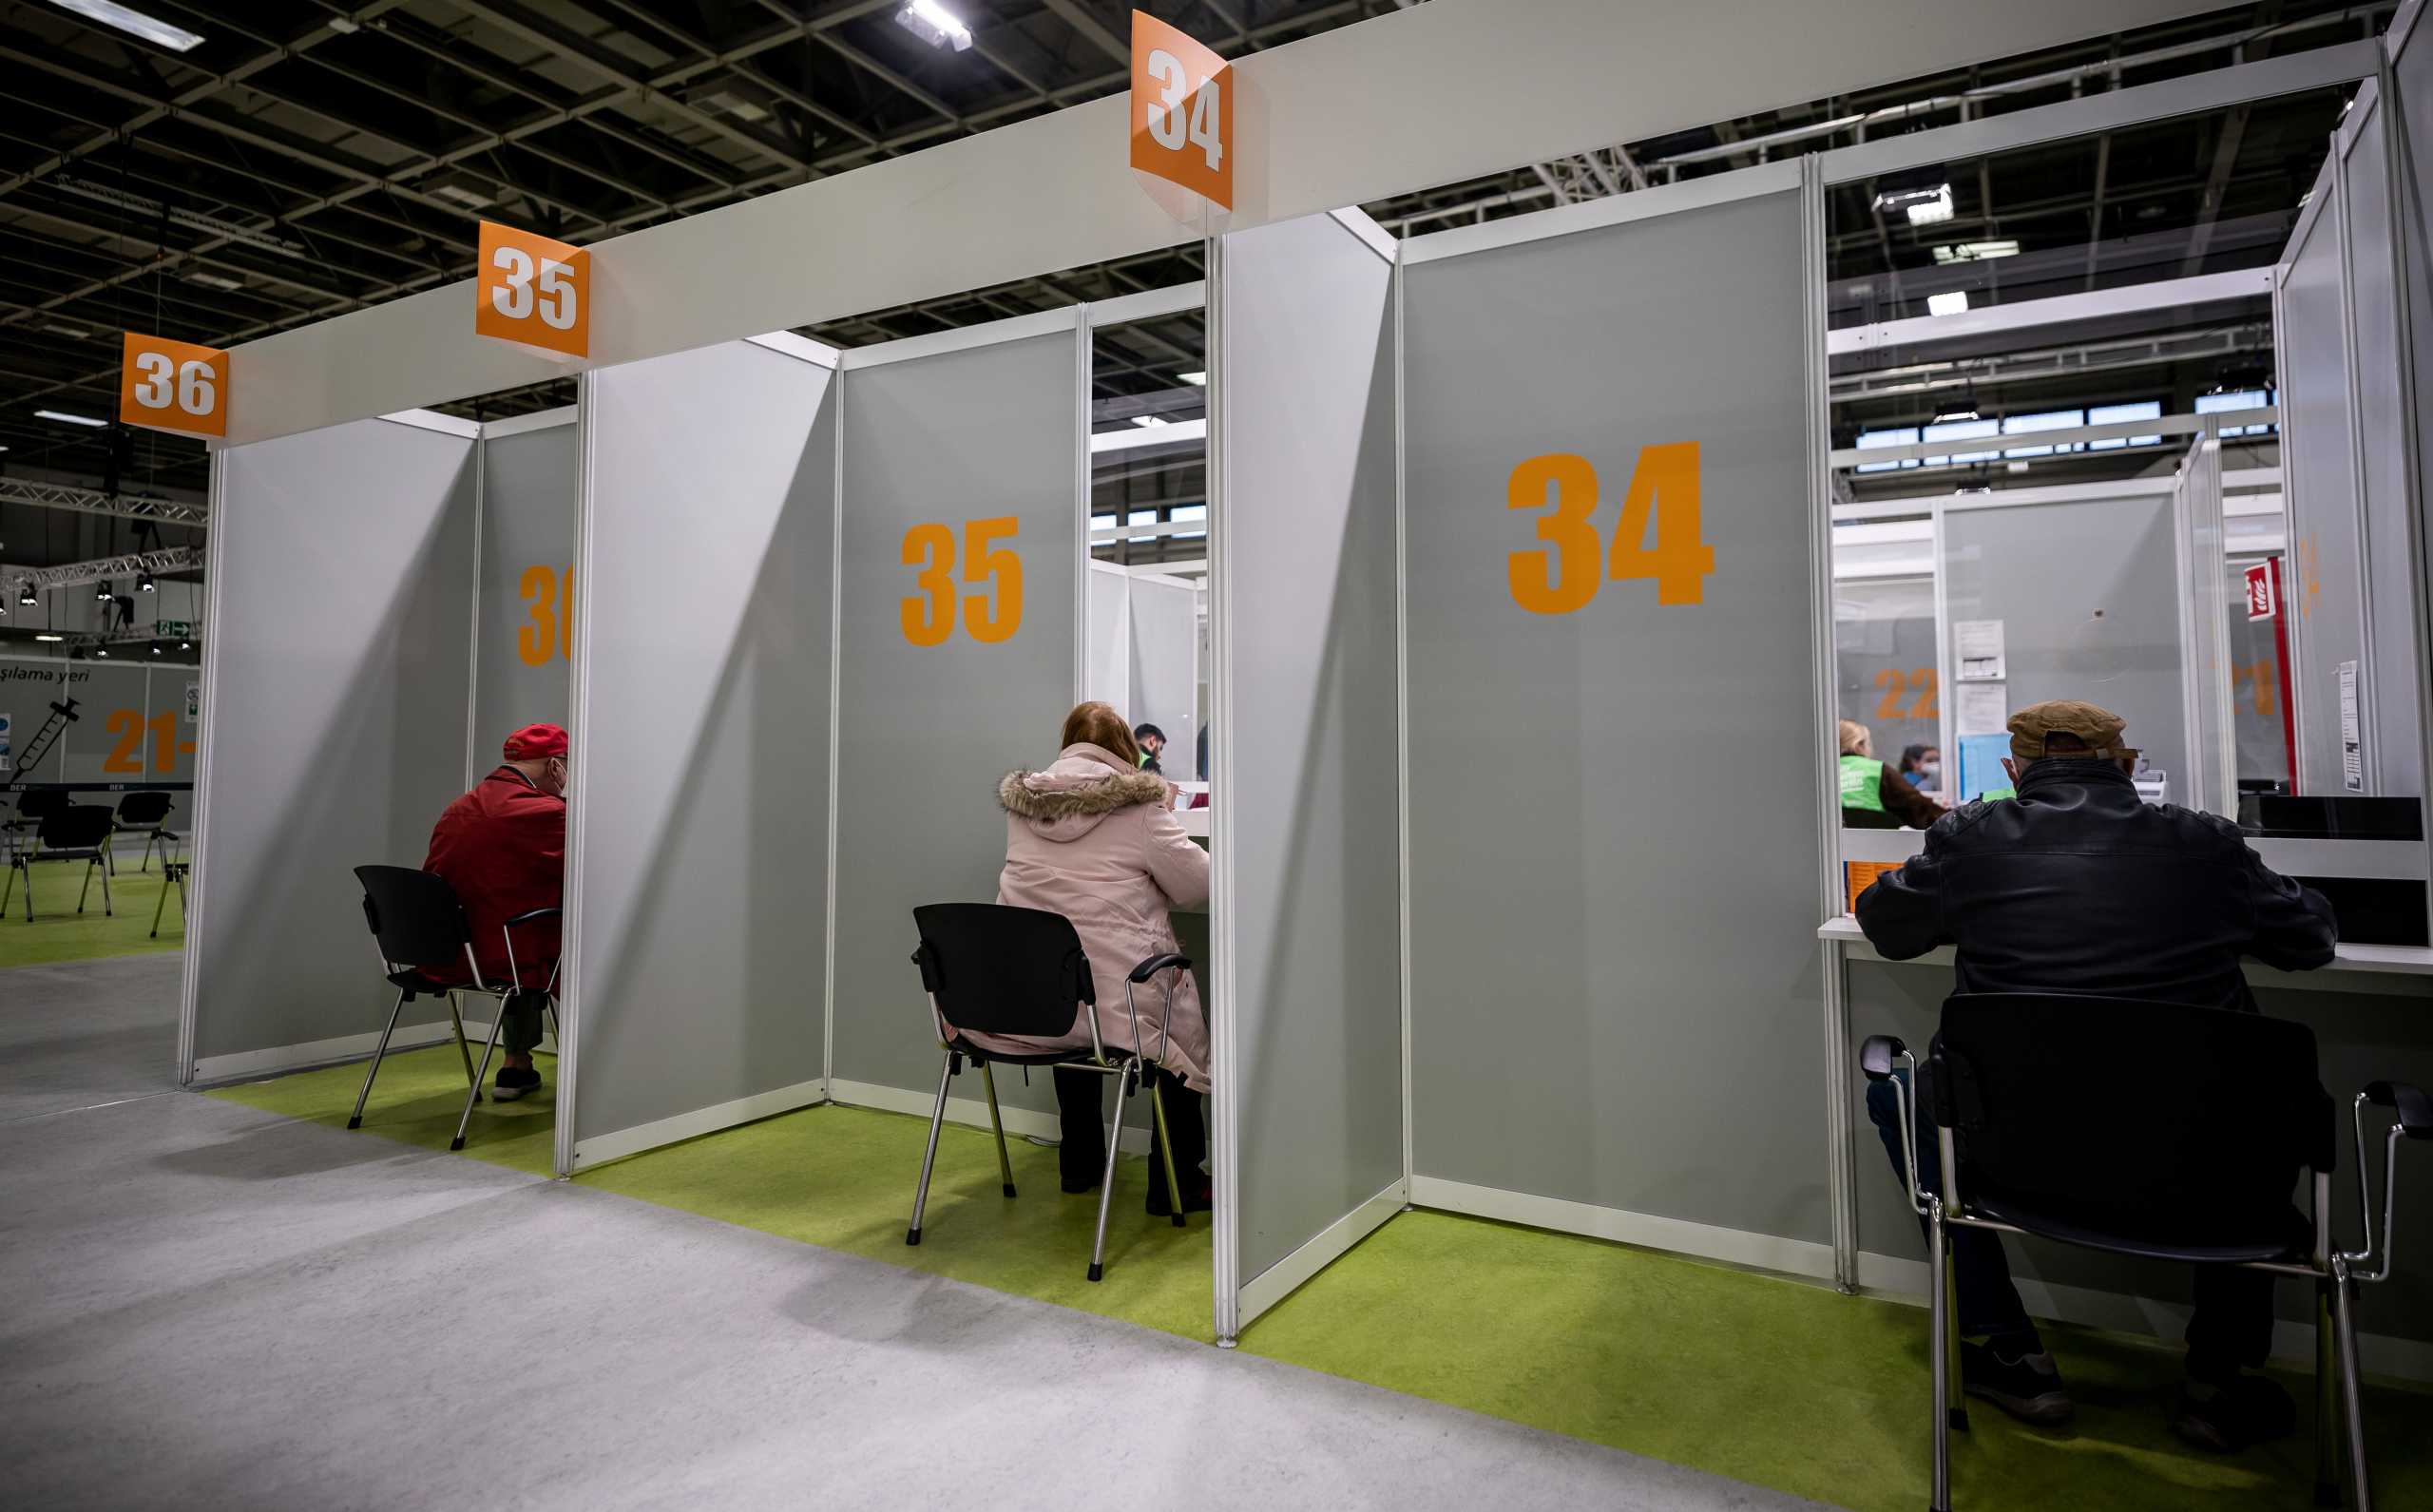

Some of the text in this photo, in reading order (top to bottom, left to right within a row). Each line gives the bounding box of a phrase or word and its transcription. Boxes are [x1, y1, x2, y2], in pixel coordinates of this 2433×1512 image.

[1147, 48, 1222, 173] 34
[491, 246, 578, 331] 35
[135, 352, 215, 415] 36
[1506, 441, 1716, 616] 34
[899, 515, 1024, 648] 35
[57, 668, 90, 684] yeri
[1873, 668, 1940, 721] 22
